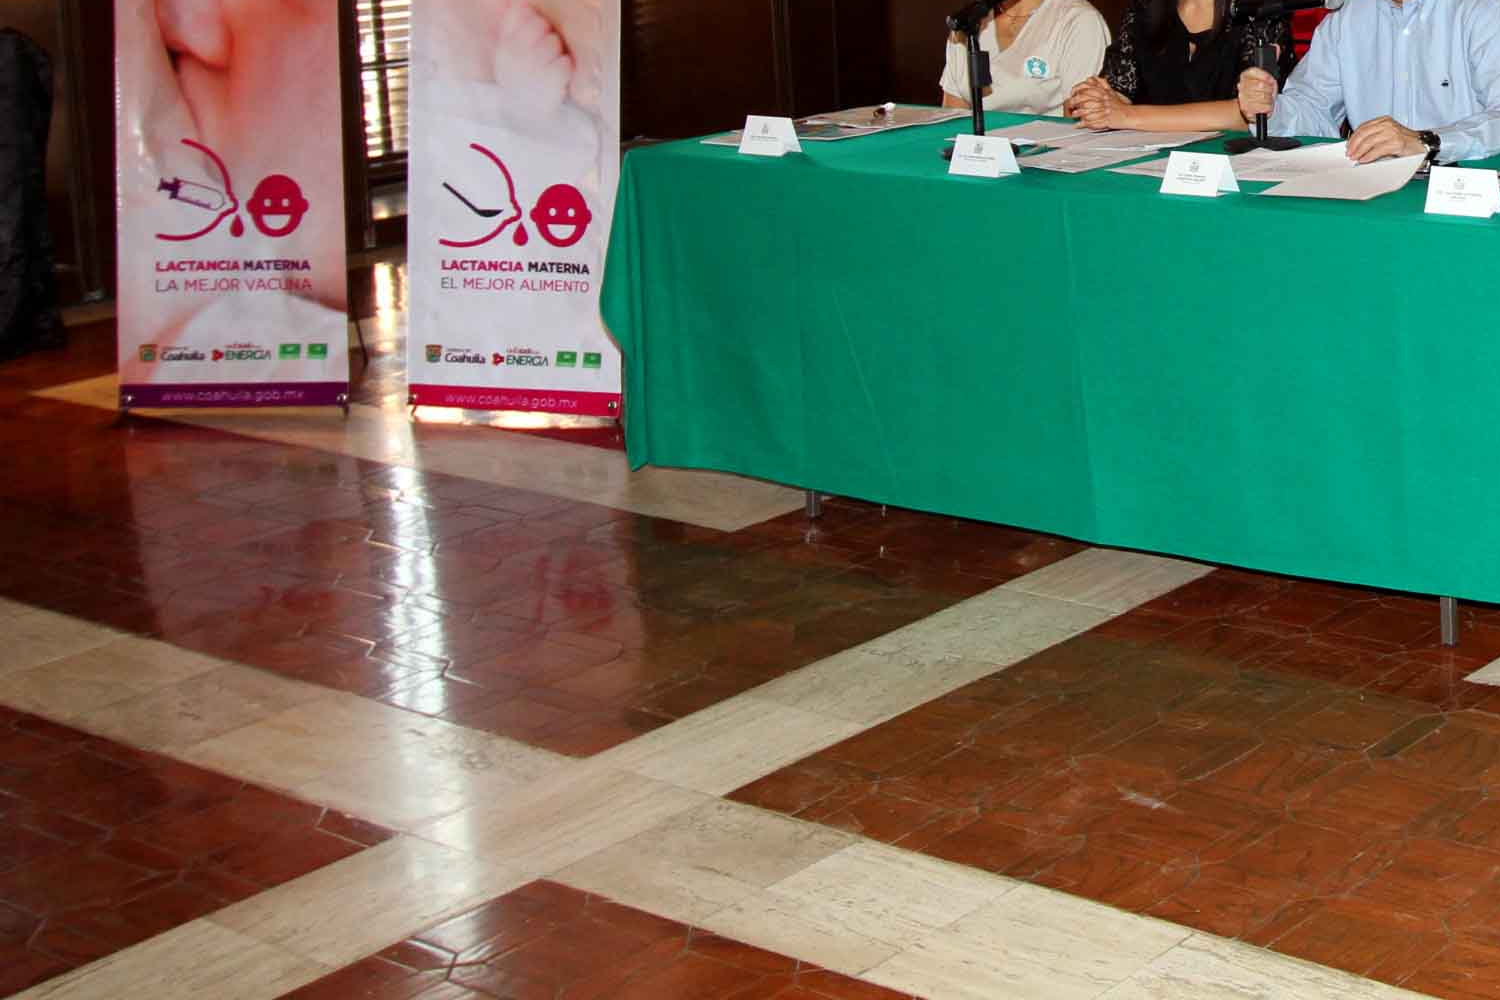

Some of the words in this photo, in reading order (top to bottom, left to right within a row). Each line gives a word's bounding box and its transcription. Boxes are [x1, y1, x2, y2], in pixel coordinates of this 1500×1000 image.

[155, 260, 240, 272] LACTANCIA
[243, 259, 311, 272] MATERNA
[441, 259, 524, 273] LACTANCIA
[528, 261, 590, 275] MATERNA
[155, 280, 179, 293] LA
[184, 278, 240, 292] MEJOR
[244, 277, 313, 291] VACUNA
[441, 277, 458, 289] EL
[463, 278, 515, 291] MEJOR
[519, 278, 590, 293] ALIMENTO
[444, 352, 486, 365] Coahuila
